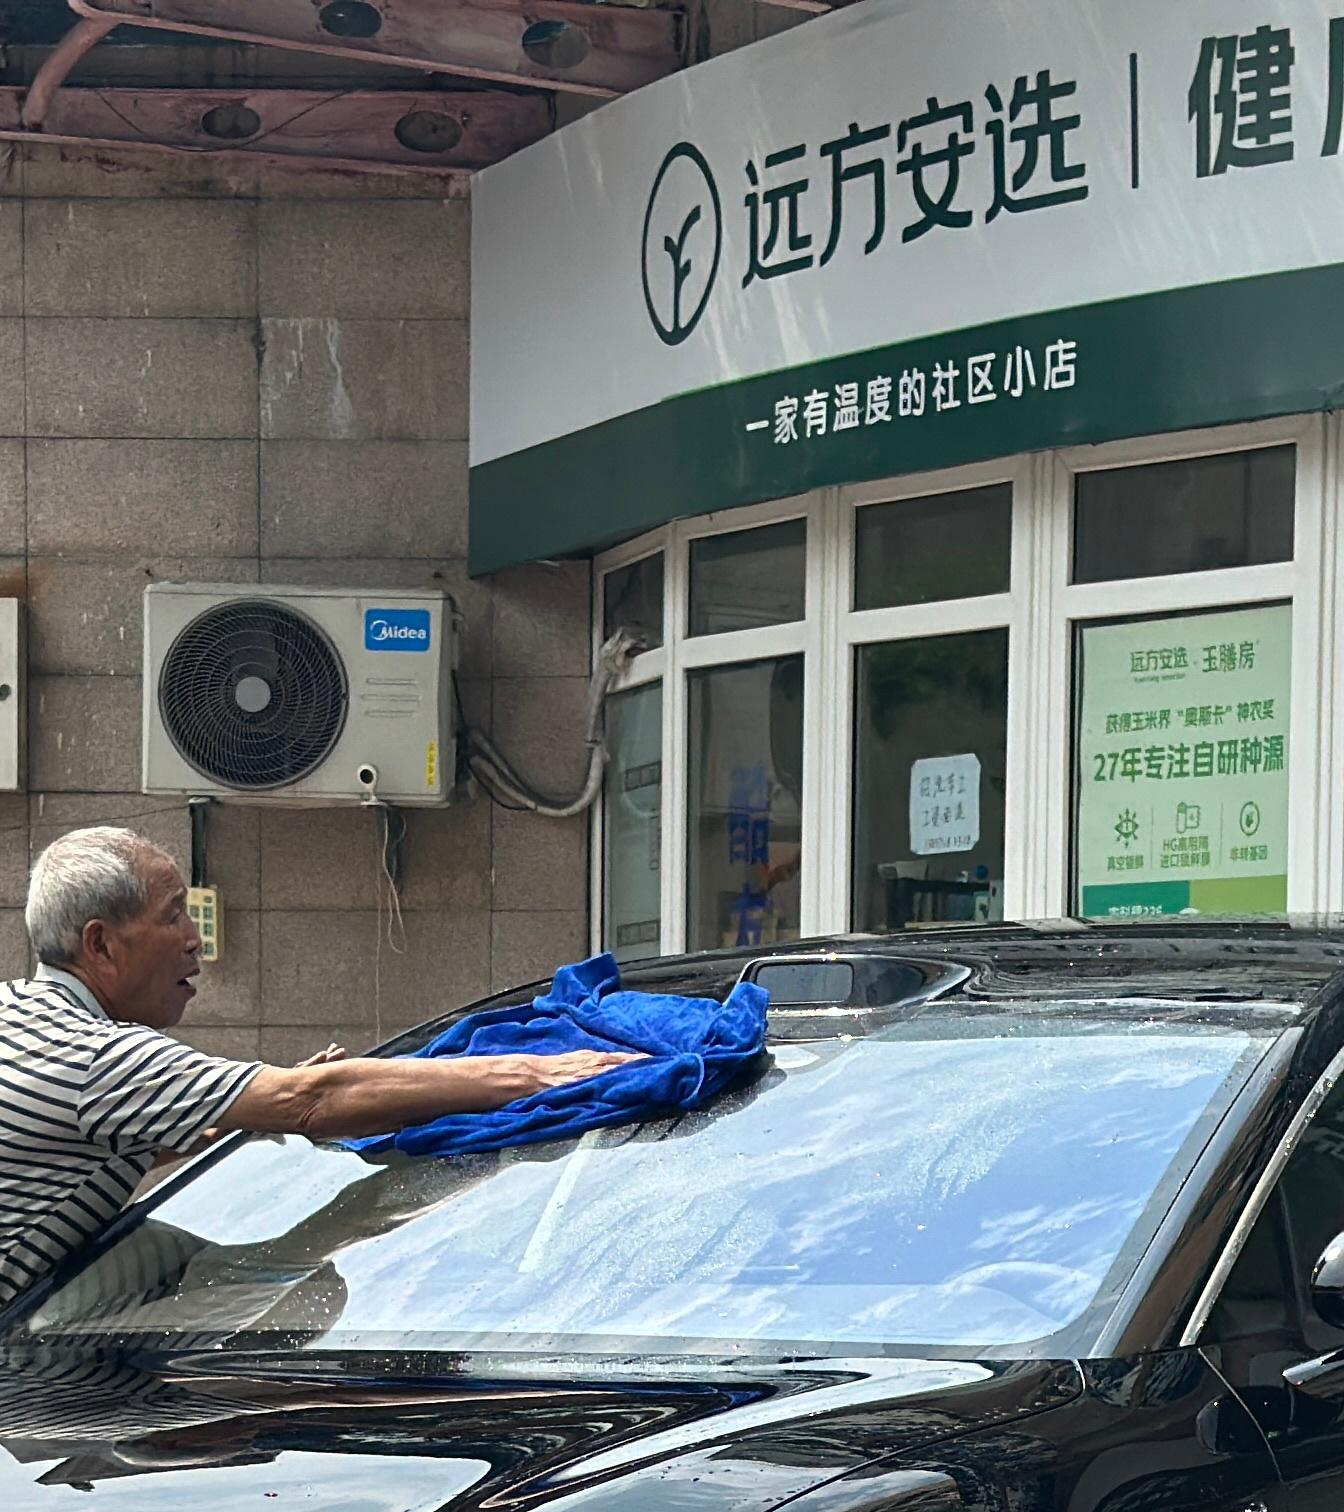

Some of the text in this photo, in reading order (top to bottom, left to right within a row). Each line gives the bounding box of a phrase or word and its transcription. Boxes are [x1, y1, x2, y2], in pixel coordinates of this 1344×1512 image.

[742, 69, 1089, 289] 远方安选
[746, 339, 1077, 444] 一家有温度的社区小店
[370, 619, 427, 640] Midea
[1093, 734, 1285, 783] 27年专注自研种源
